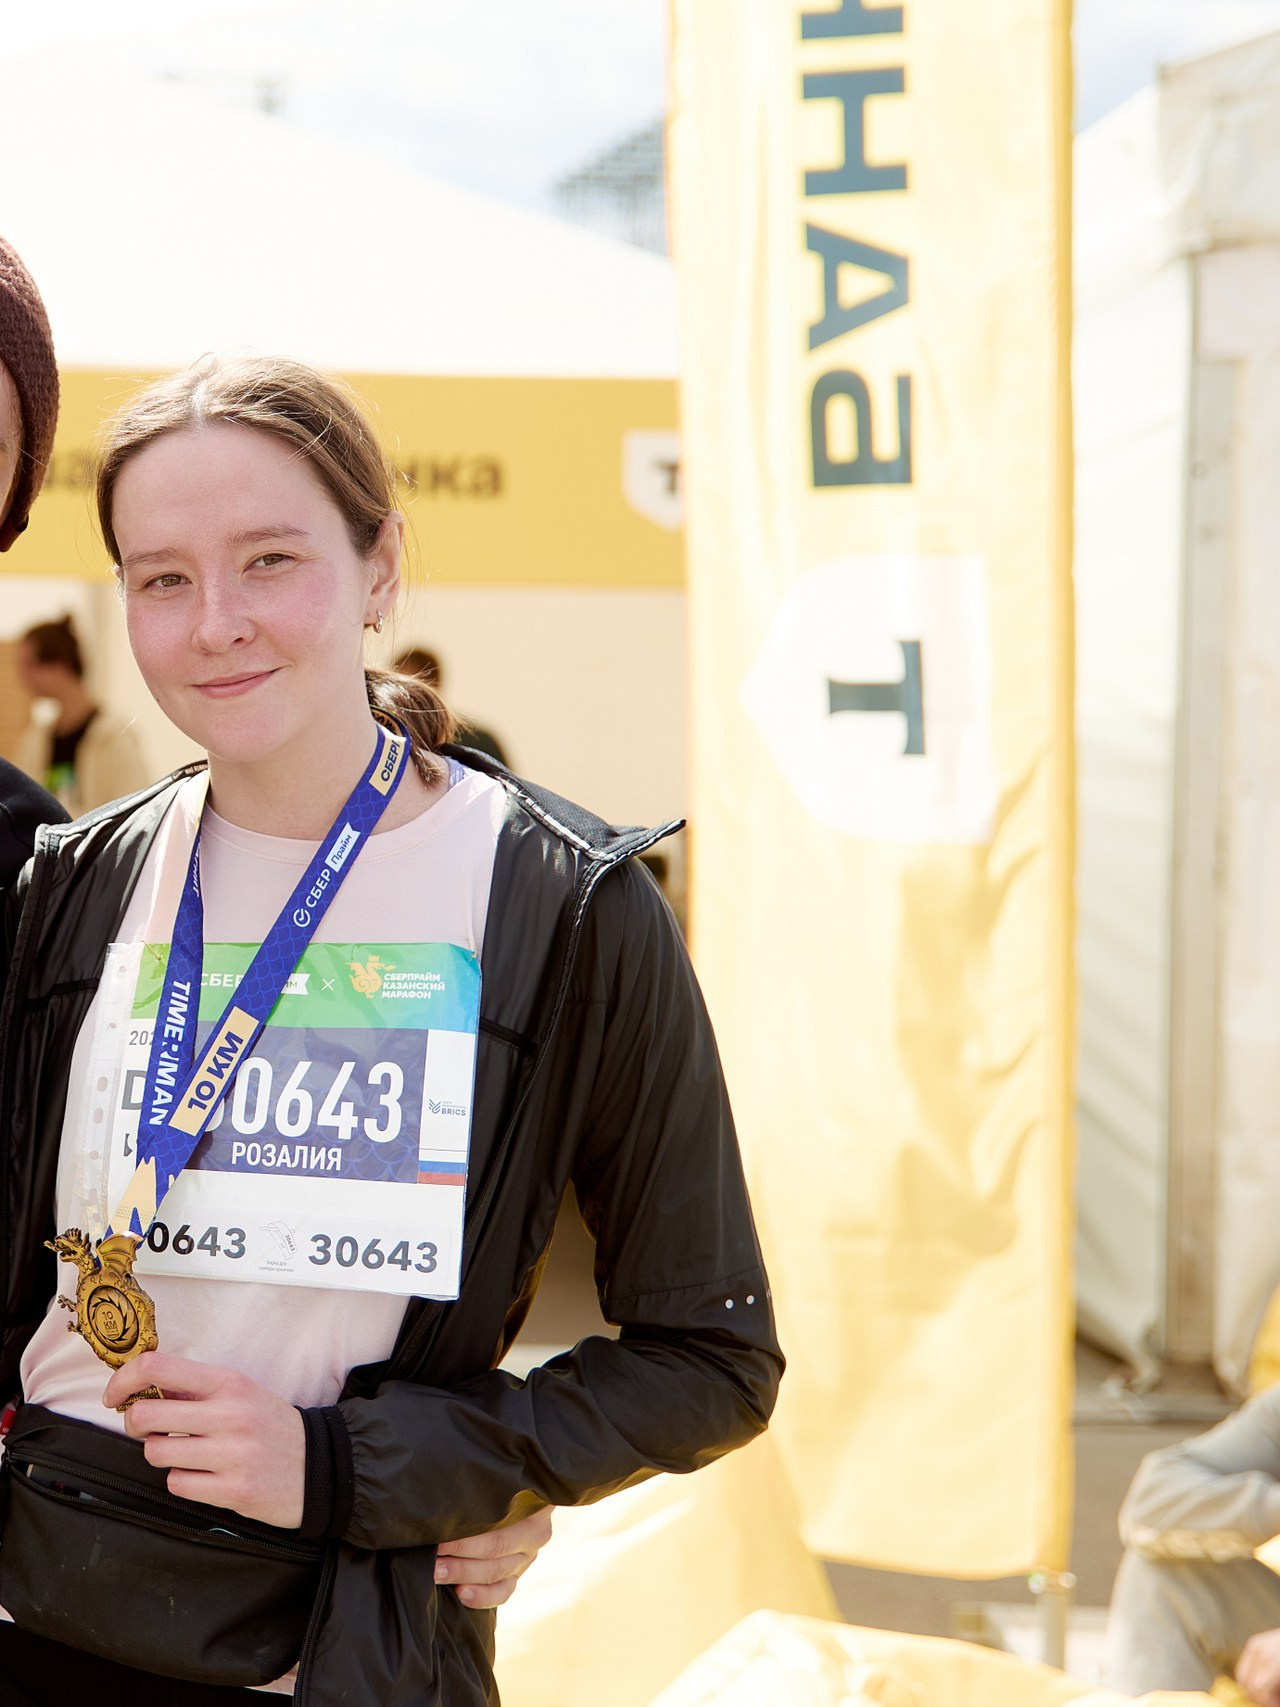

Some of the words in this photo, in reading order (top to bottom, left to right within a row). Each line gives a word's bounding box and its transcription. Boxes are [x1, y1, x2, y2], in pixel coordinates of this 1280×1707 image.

[306, 868, 331, 908] СБЕР
[331, 834, 353, 865] Прайм
[382, 981, 446, 991] КАЗАНСКИЙ
[384, 972, 440, 981] СБЕРПРАЙМ
[381, 991, 432, 999] МАРАФОН
[187, 1080, 216, 1111] 10
[206, 1057, 404, 1143] 0643
[441, 1108, 466, 1116] BRICS
[232, 1142, 342, 1171] РОЗАЛИЯ
[147, 1221, 246, 1259] 0643
[308, 1233, 438, 1274] 30643
[102, 1311, 113, 1320] 10
